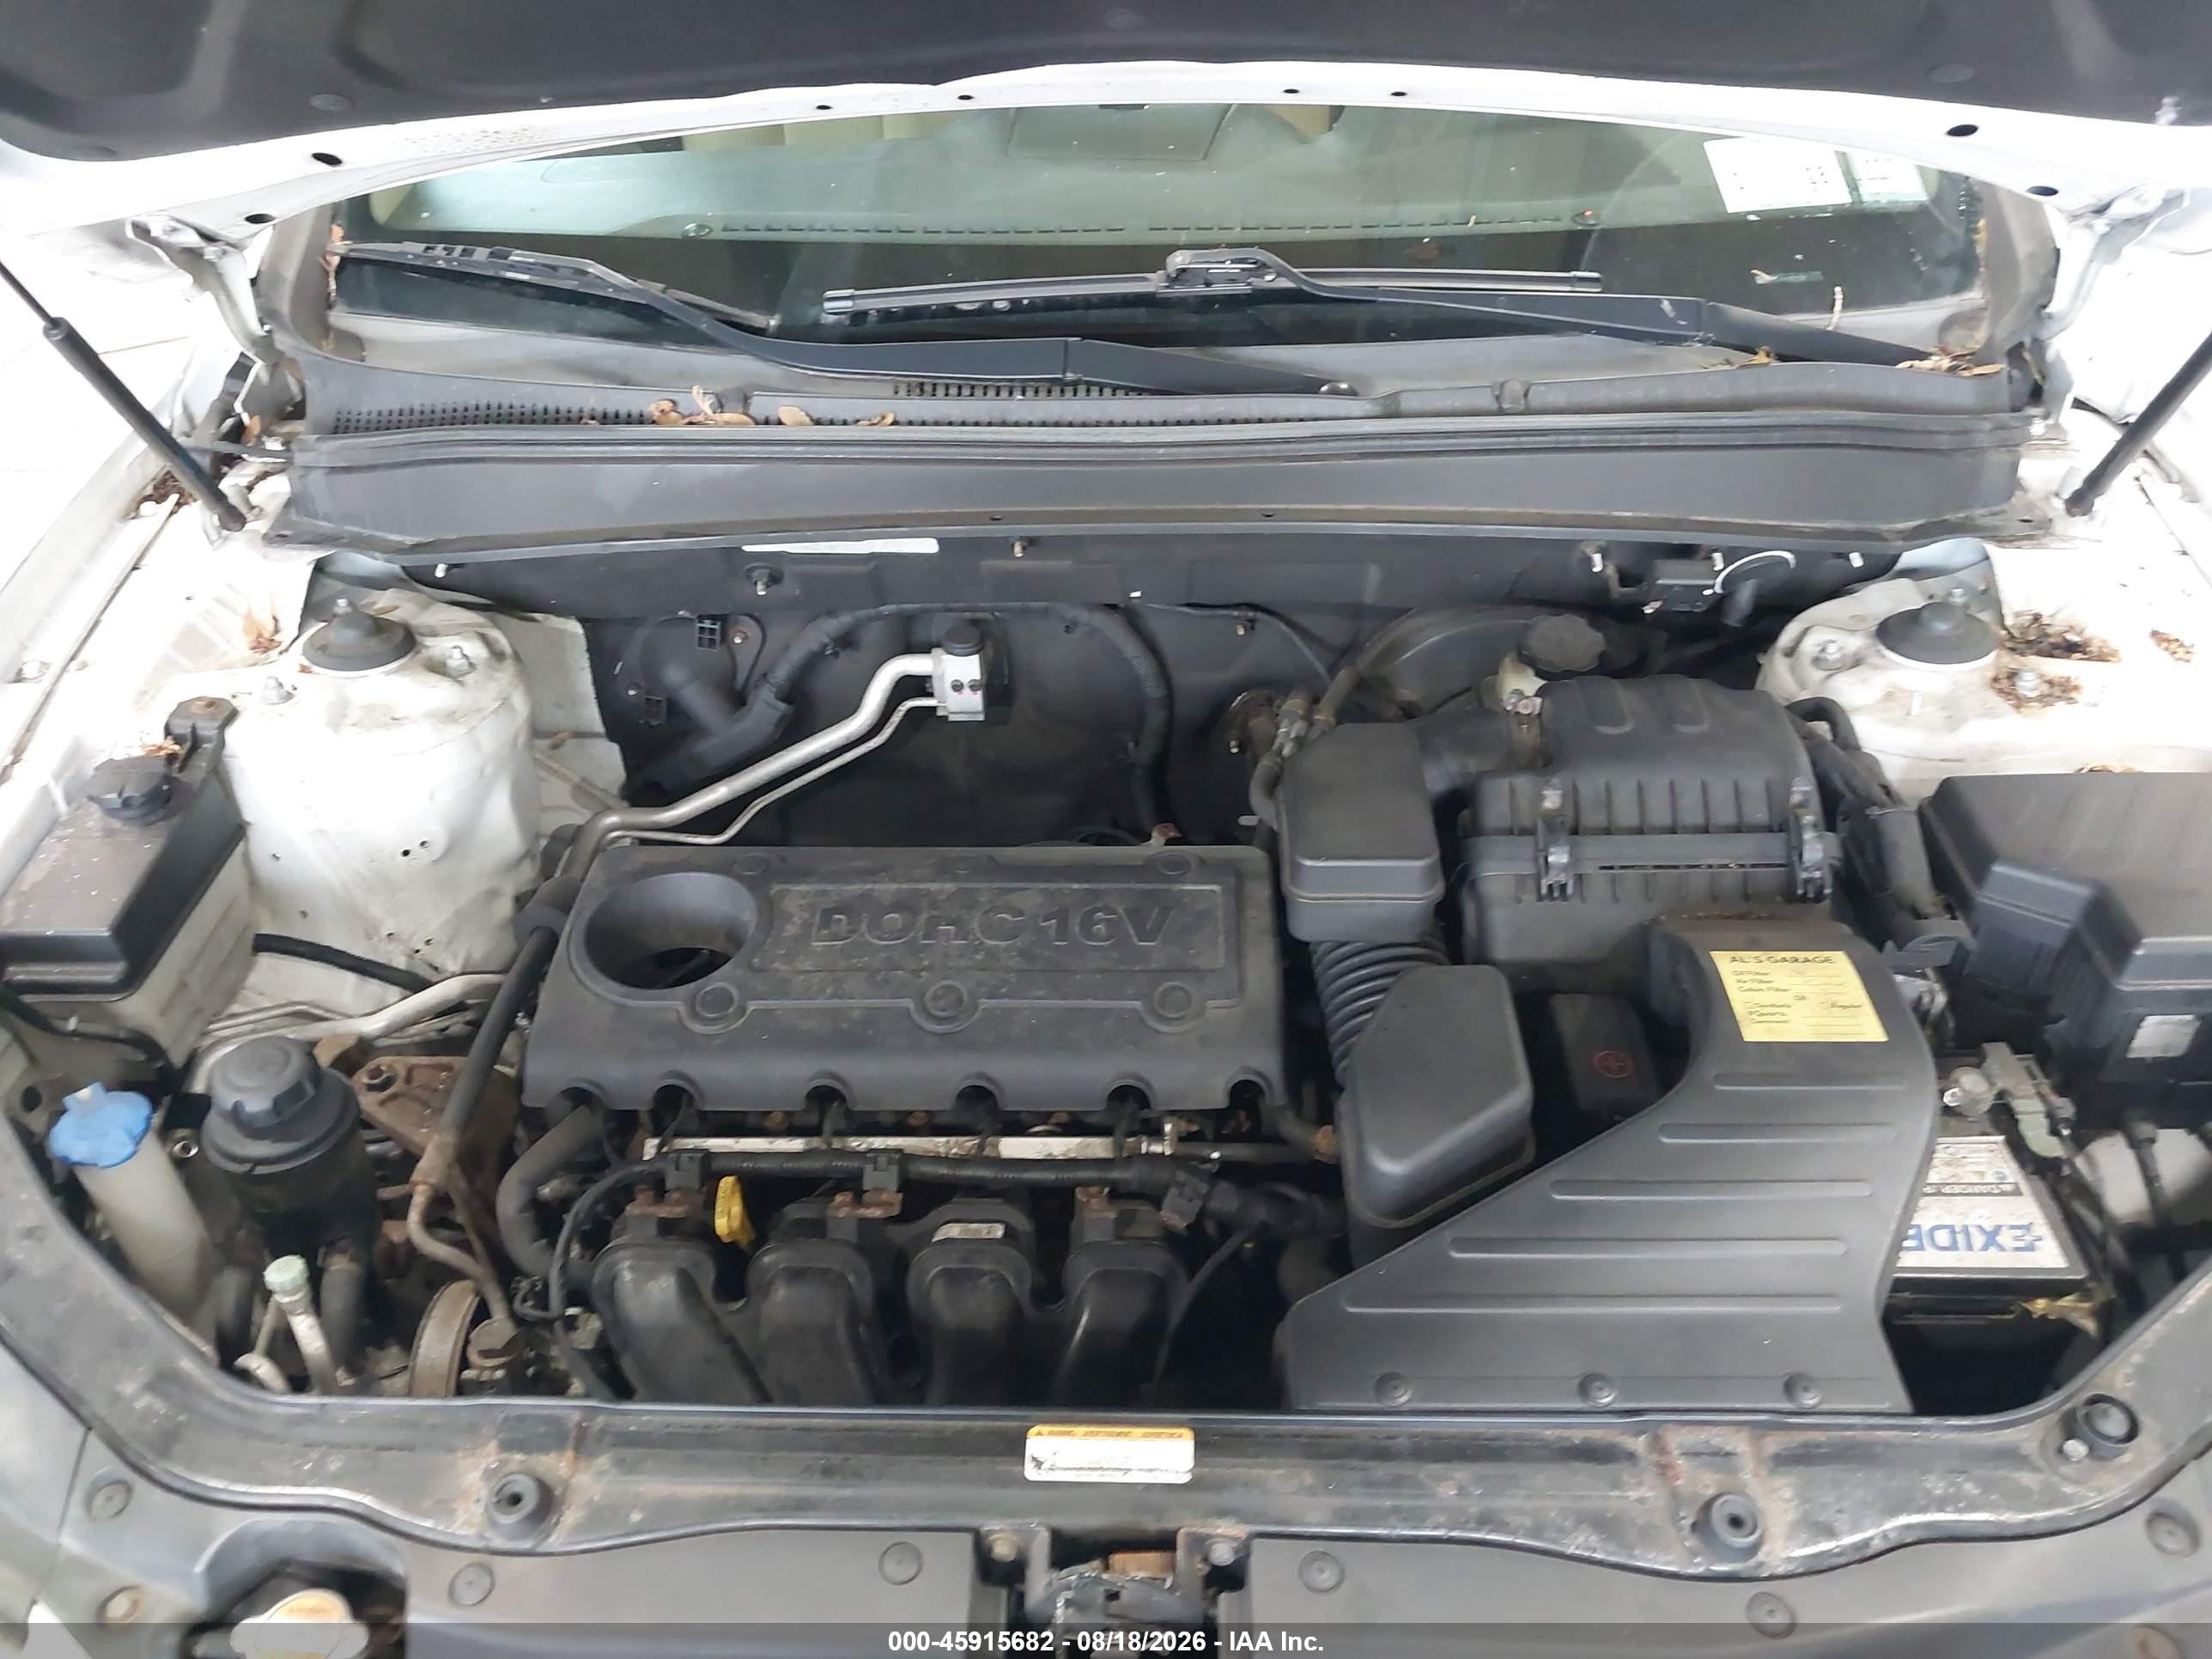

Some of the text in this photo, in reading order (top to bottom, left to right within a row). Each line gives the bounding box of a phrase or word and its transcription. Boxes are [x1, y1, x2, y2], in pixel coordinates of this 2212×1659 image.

[811, 905, 1173, 945] DOHC 16V
[1765, 955, 1835, 963] GARAGE
[1901, 1224, 2042, 1252] EXIDE
